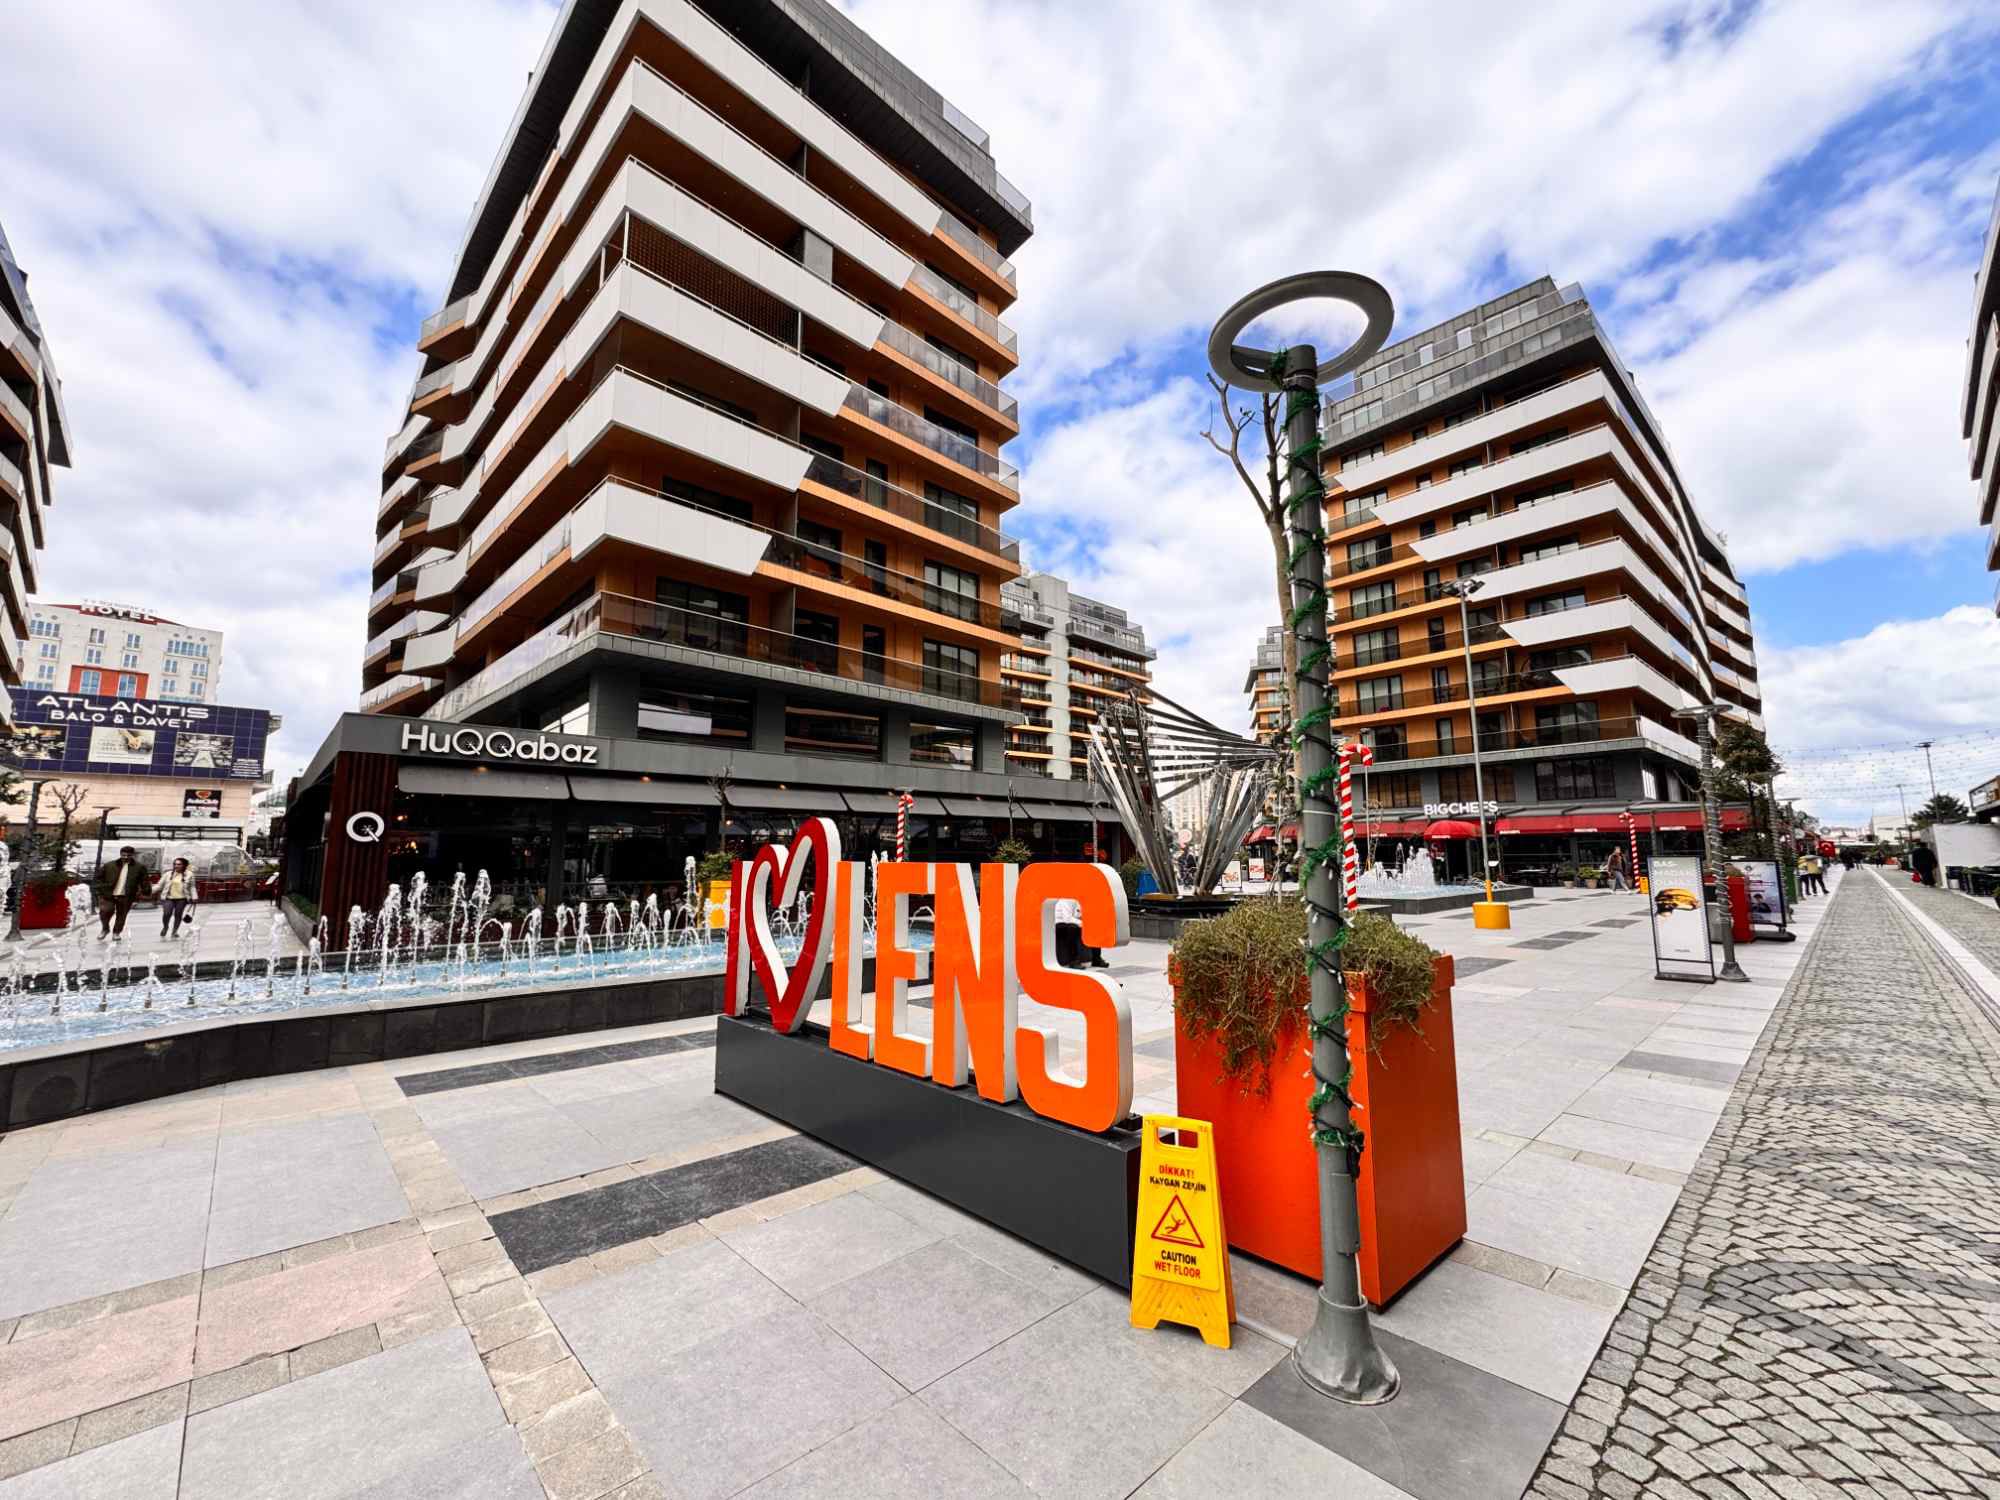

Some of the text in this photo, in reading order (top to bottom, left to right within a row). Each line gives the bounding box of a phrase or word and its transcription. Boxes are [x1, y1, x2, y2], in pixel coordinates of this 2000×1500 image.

[80, 603, 155, 622] HOTEL
[37, 695, 209, 719] ATLANTIS
[50, 710, 195, 728] BALO & DAVET
[400, 723, 598, 764] HuQQabaz
[346, 811, 385, 842] Q
[829, 862, 1134, 1133] LENS
[1161, 1250, 1197, 1265] CAUTION
[1154, 1260, 1201, 1279] WET FLOOR
